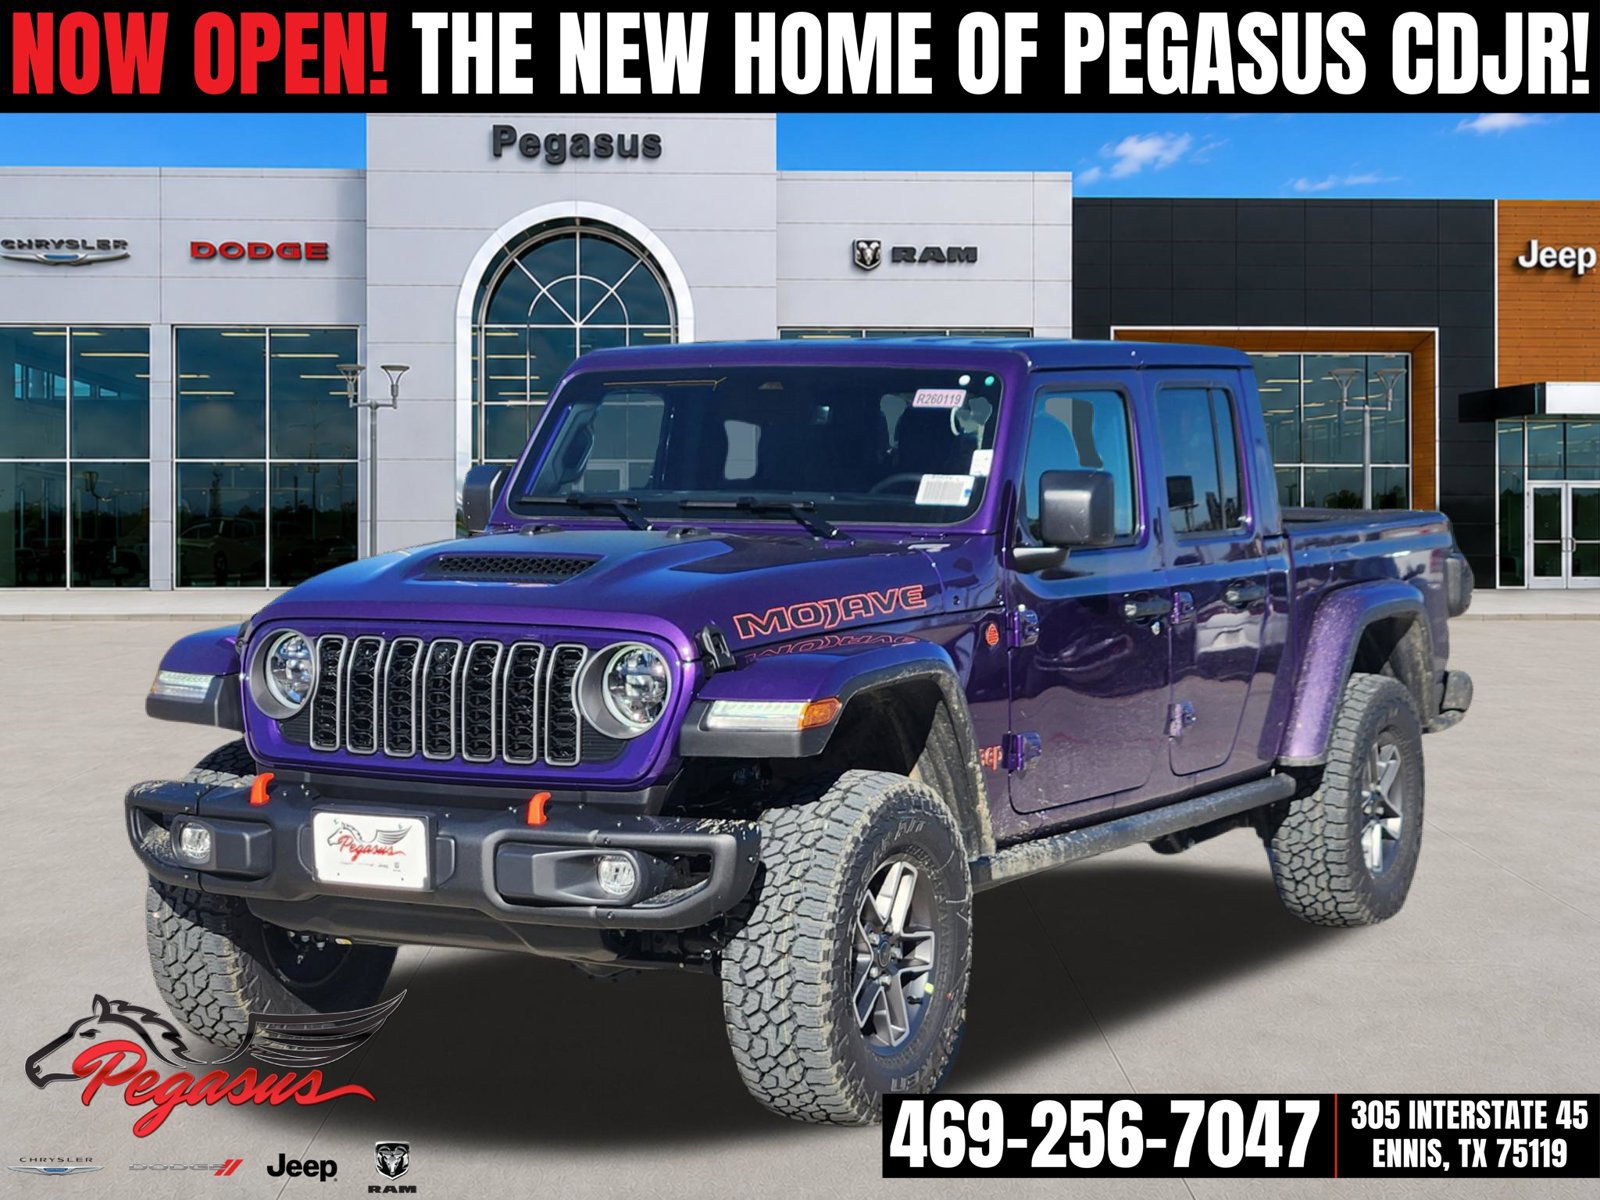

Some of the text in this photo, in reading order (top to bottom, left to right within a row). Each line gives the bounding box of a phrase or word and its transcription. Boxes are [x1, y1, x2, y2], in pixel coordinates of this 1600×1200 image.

[492, 124, 662, 167] Pegasus
[0, 238, 129, 251] CHRYSLER
[190, 240, 329, 261] DODGE
[891, 246, 978, 264] RAM
[1517, 239, 1597, 275] Jeep
[915, 393, 962, 406] R260119
[733, 584, 927, 640] MOJAVE
[337, 834, 407, 862] Pegasus
